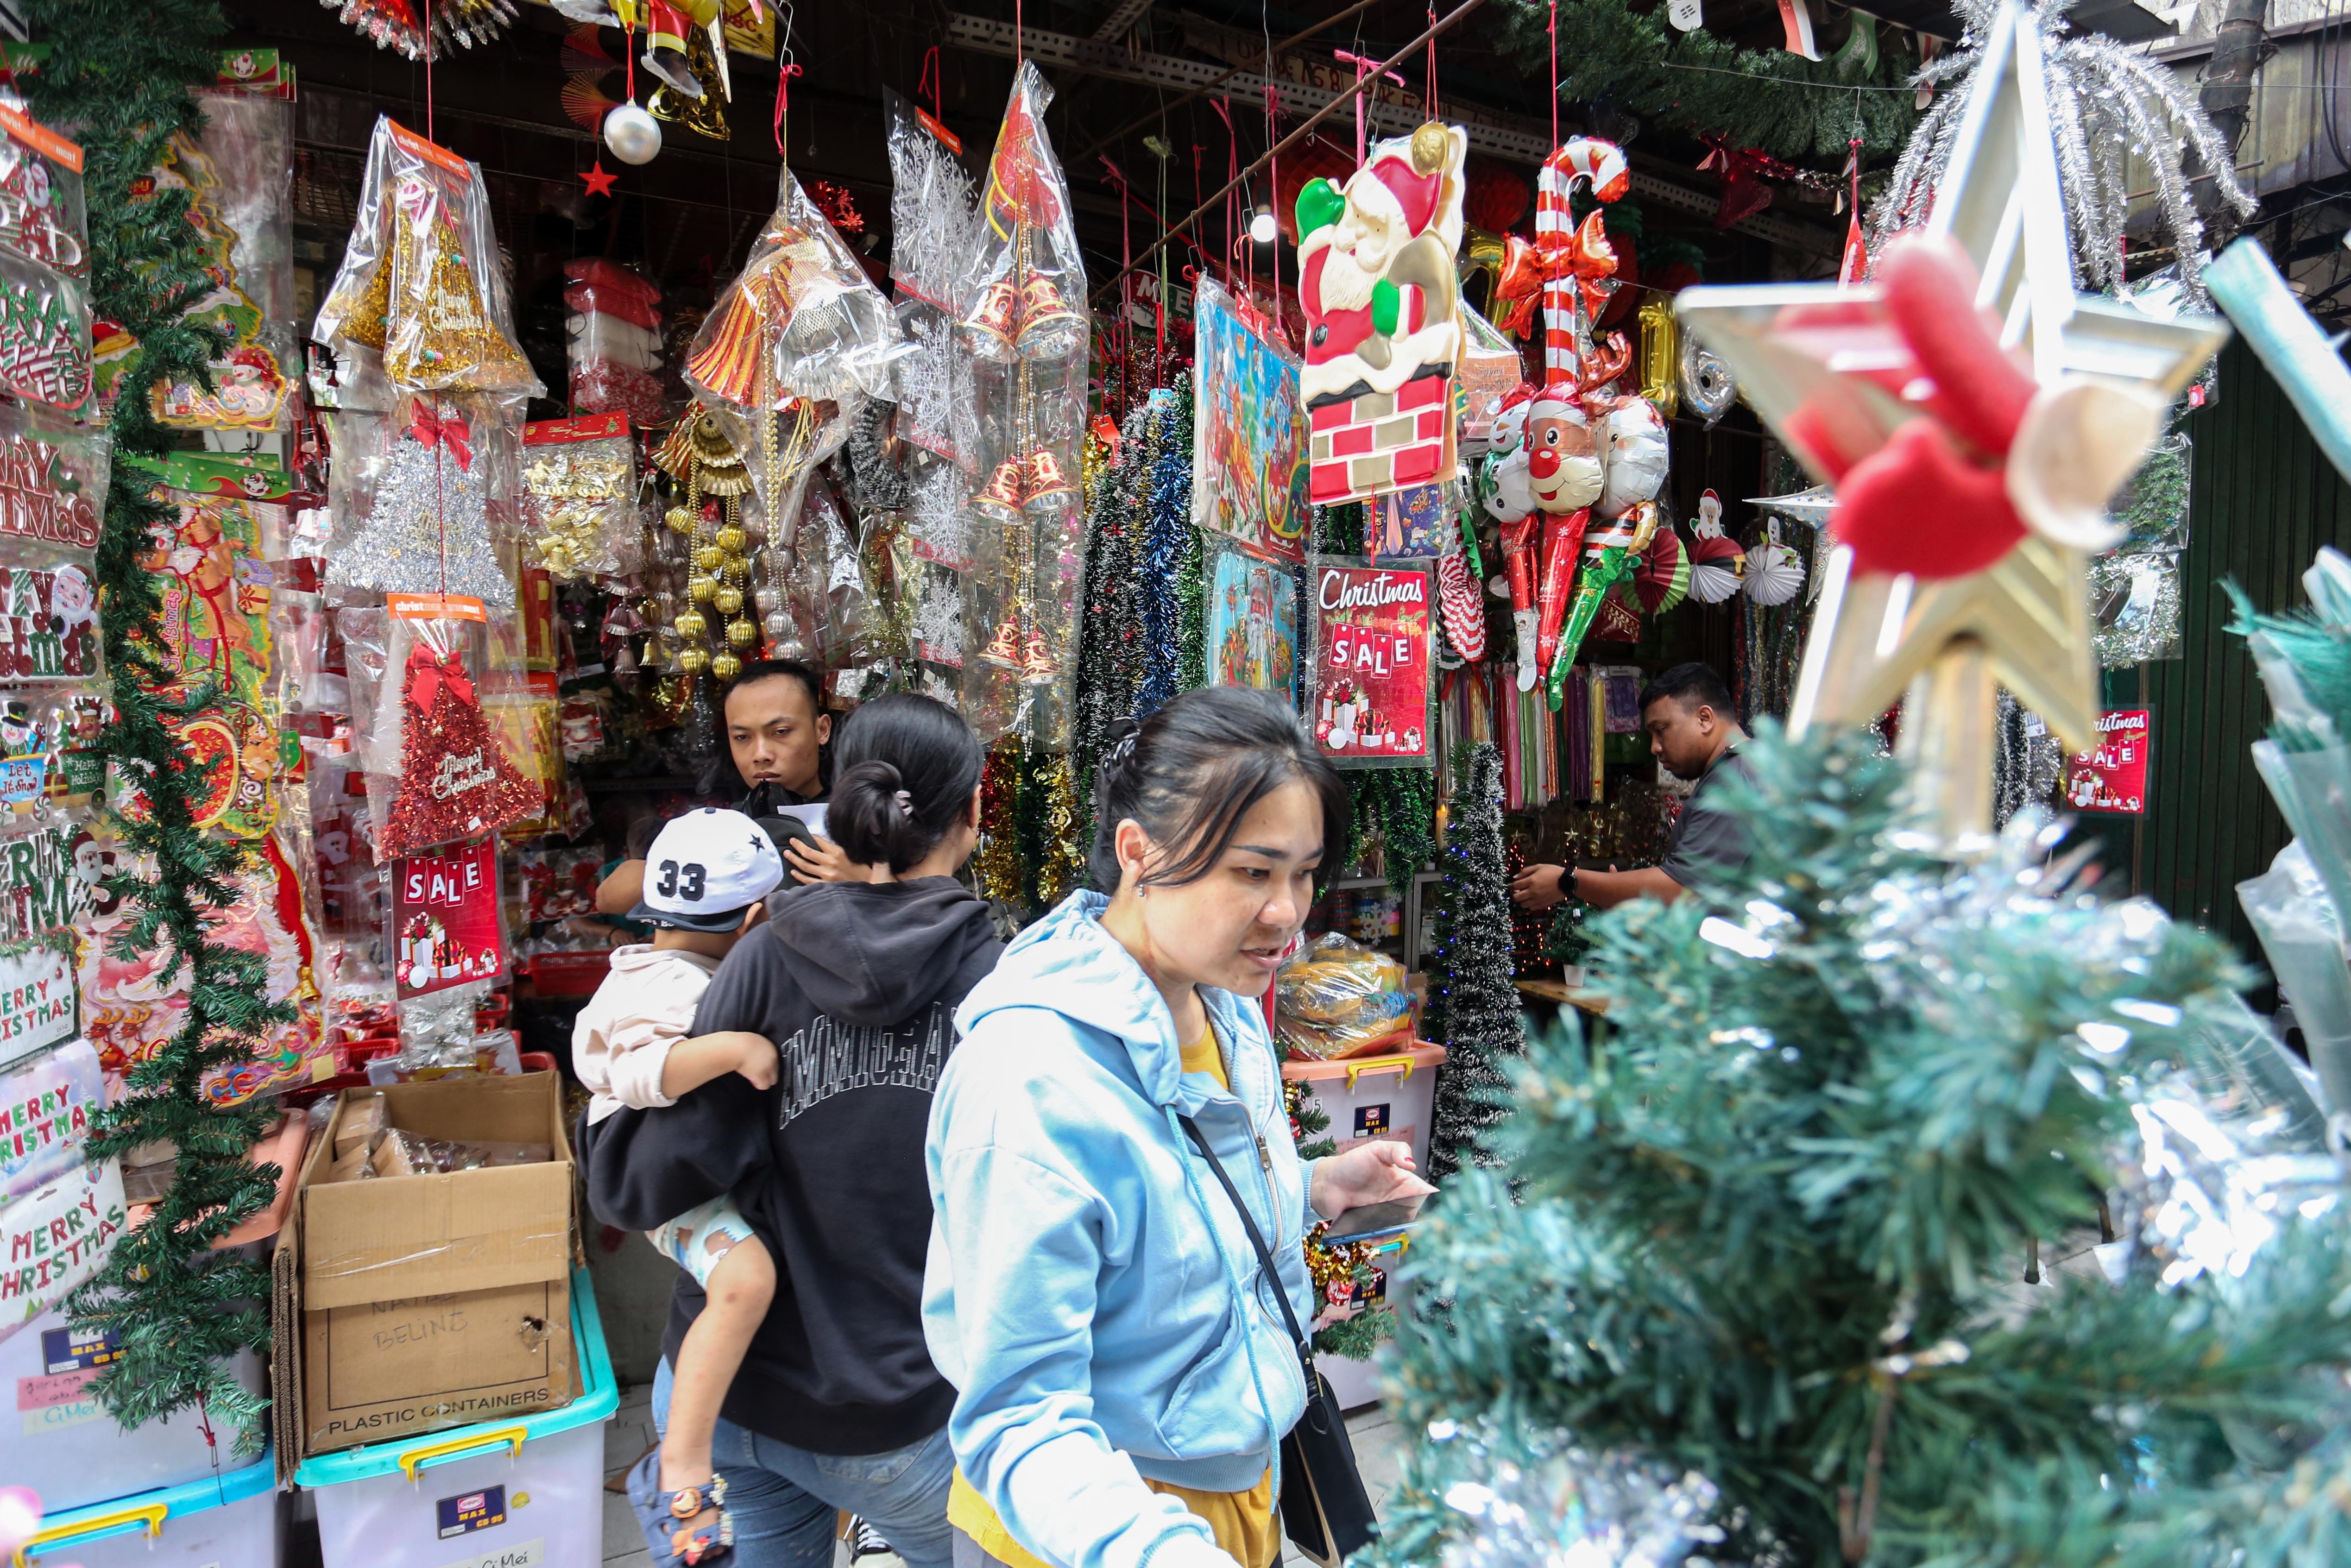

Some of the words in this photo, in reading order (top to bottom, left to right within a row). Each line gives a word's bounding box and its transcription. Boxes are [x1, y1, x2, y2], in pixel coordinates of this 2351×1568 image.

[1318, 569, 1423, 611] Christmas
[1332, 638, 1409, 674] SALE
[2092, 712, 2145, 732] ristmas
[9, 762, 32, 777] Let
[2078, 747, 2133, 768] SALE
[3, 780, 14, 793] It
[16, 777, 38, 792] Snow
[408, 862, 479, 903] SALE
[656, 859, 706, 901] 33
[12, 1192, 98, 1263] MERRY
[0, 1204, 125, 1300] HRISTMAS
[329, 1409, 415, 1435] PLASTIC
[422, 1388, 549, 1418] CONTAINERS
[459, 1508, 486, 1522] MAX
